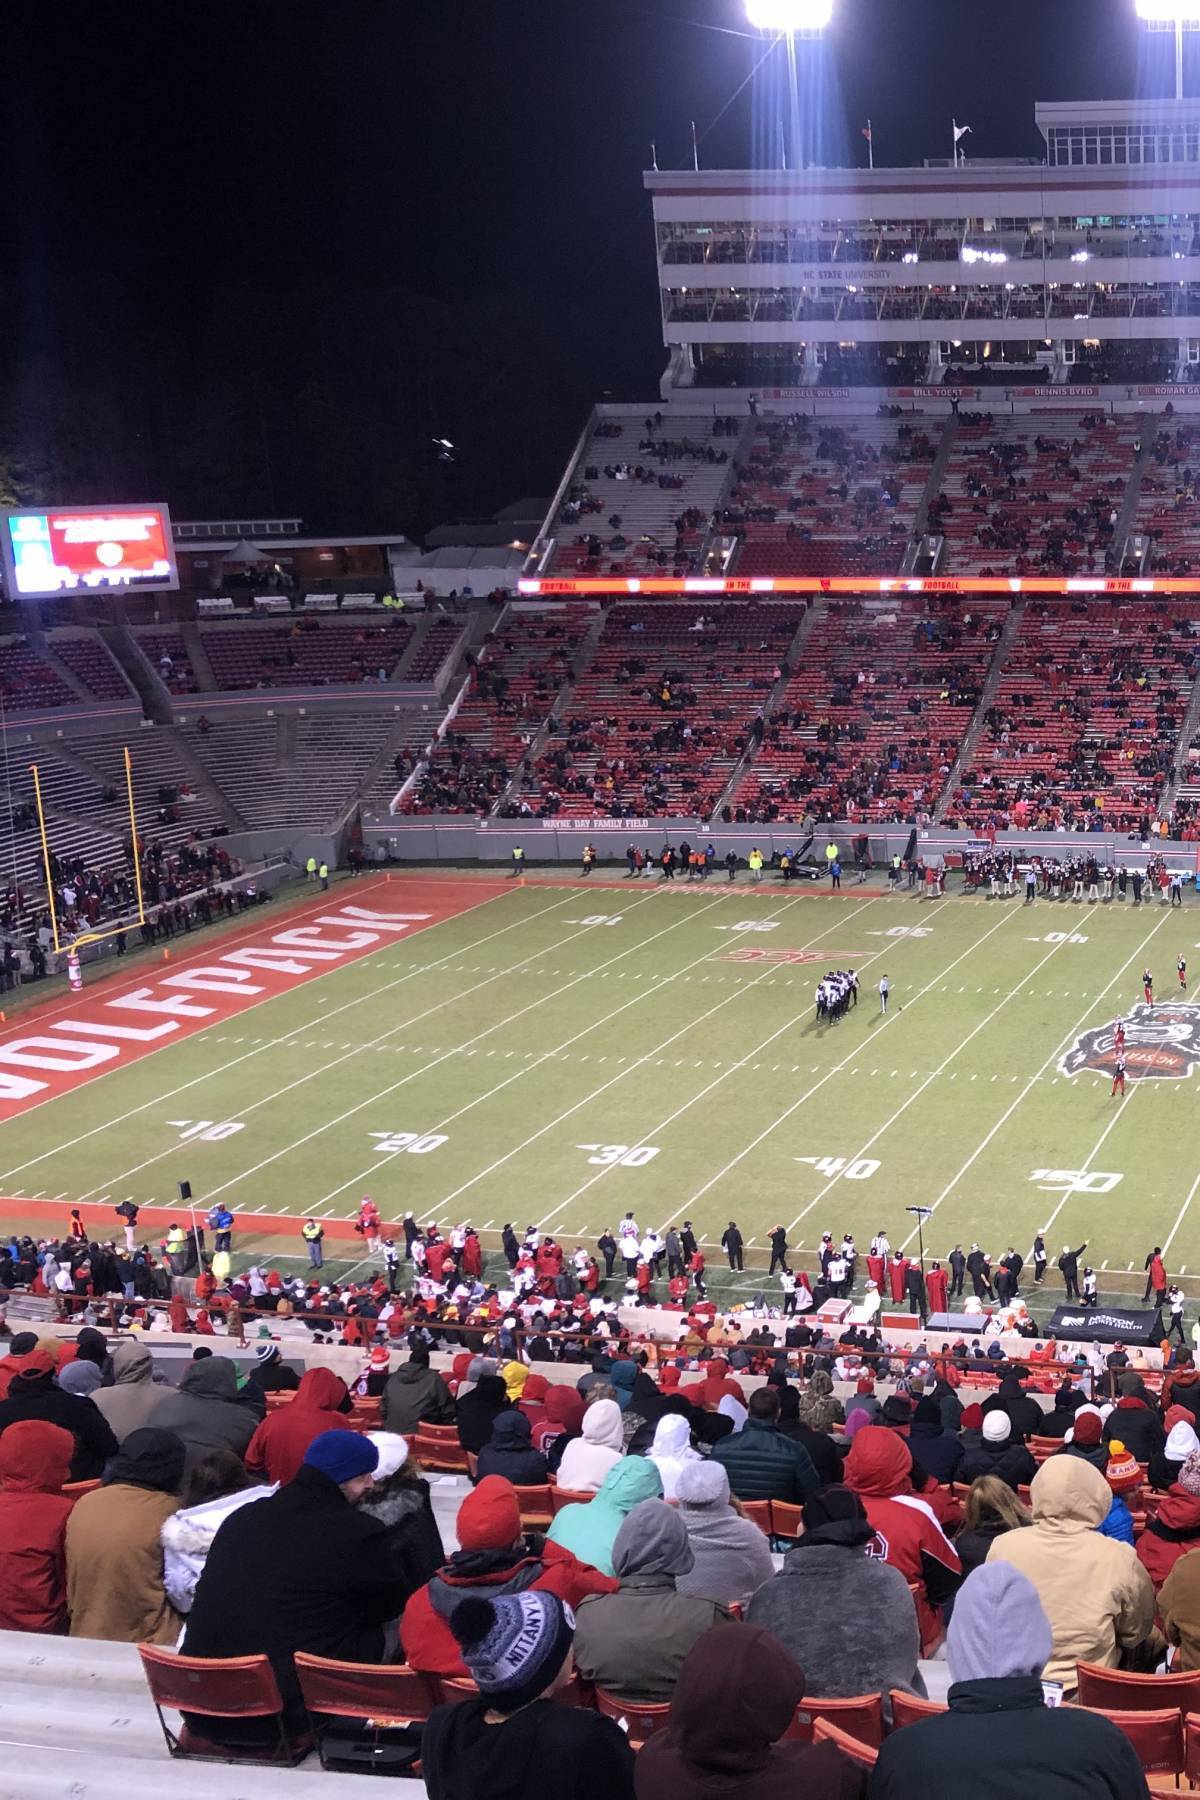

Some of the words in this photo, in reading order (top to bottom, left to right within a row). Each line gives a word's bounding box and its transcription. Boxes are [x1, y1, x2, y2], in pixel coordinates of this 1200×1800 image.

[818, 270, 842, 279] STATE
[845, 269, 891, 279] UNIVERSITY
[1034, 387, 1067, 396] DENNIS
[1069, 387, 1093, 396] BYRD
[1155, 386, 1185, 394] ROMAN
[540, 582, 576, 591] FOOTBALL
[726, 582, 736, 590] IN
[738, 582, 751, 590] THE
[923, 582, 960, 590] FOOTBALL
[1106, 582, 1116, 590] IN
[1118, 582, 1131, 590] THE
[542, 819, 571, 828] WAYNE
[575, 819, 590, 828] DAY
[593, 819, 622, 828] FAMILY
[626, 819, 648, 828] FIELD
[731, 921, 781, 932] 20
[884, 926, 933, 938] 30
[1044, 932, 1088, 944] 40
[179, 1121, 245, 1141] 10
[373, 1132, 449, 1153] 20
[587, 1145, 660, 1167] 30
[813, 1156, 881, 1180] 40
[505, 1606, 542, 1667] NITTANY
